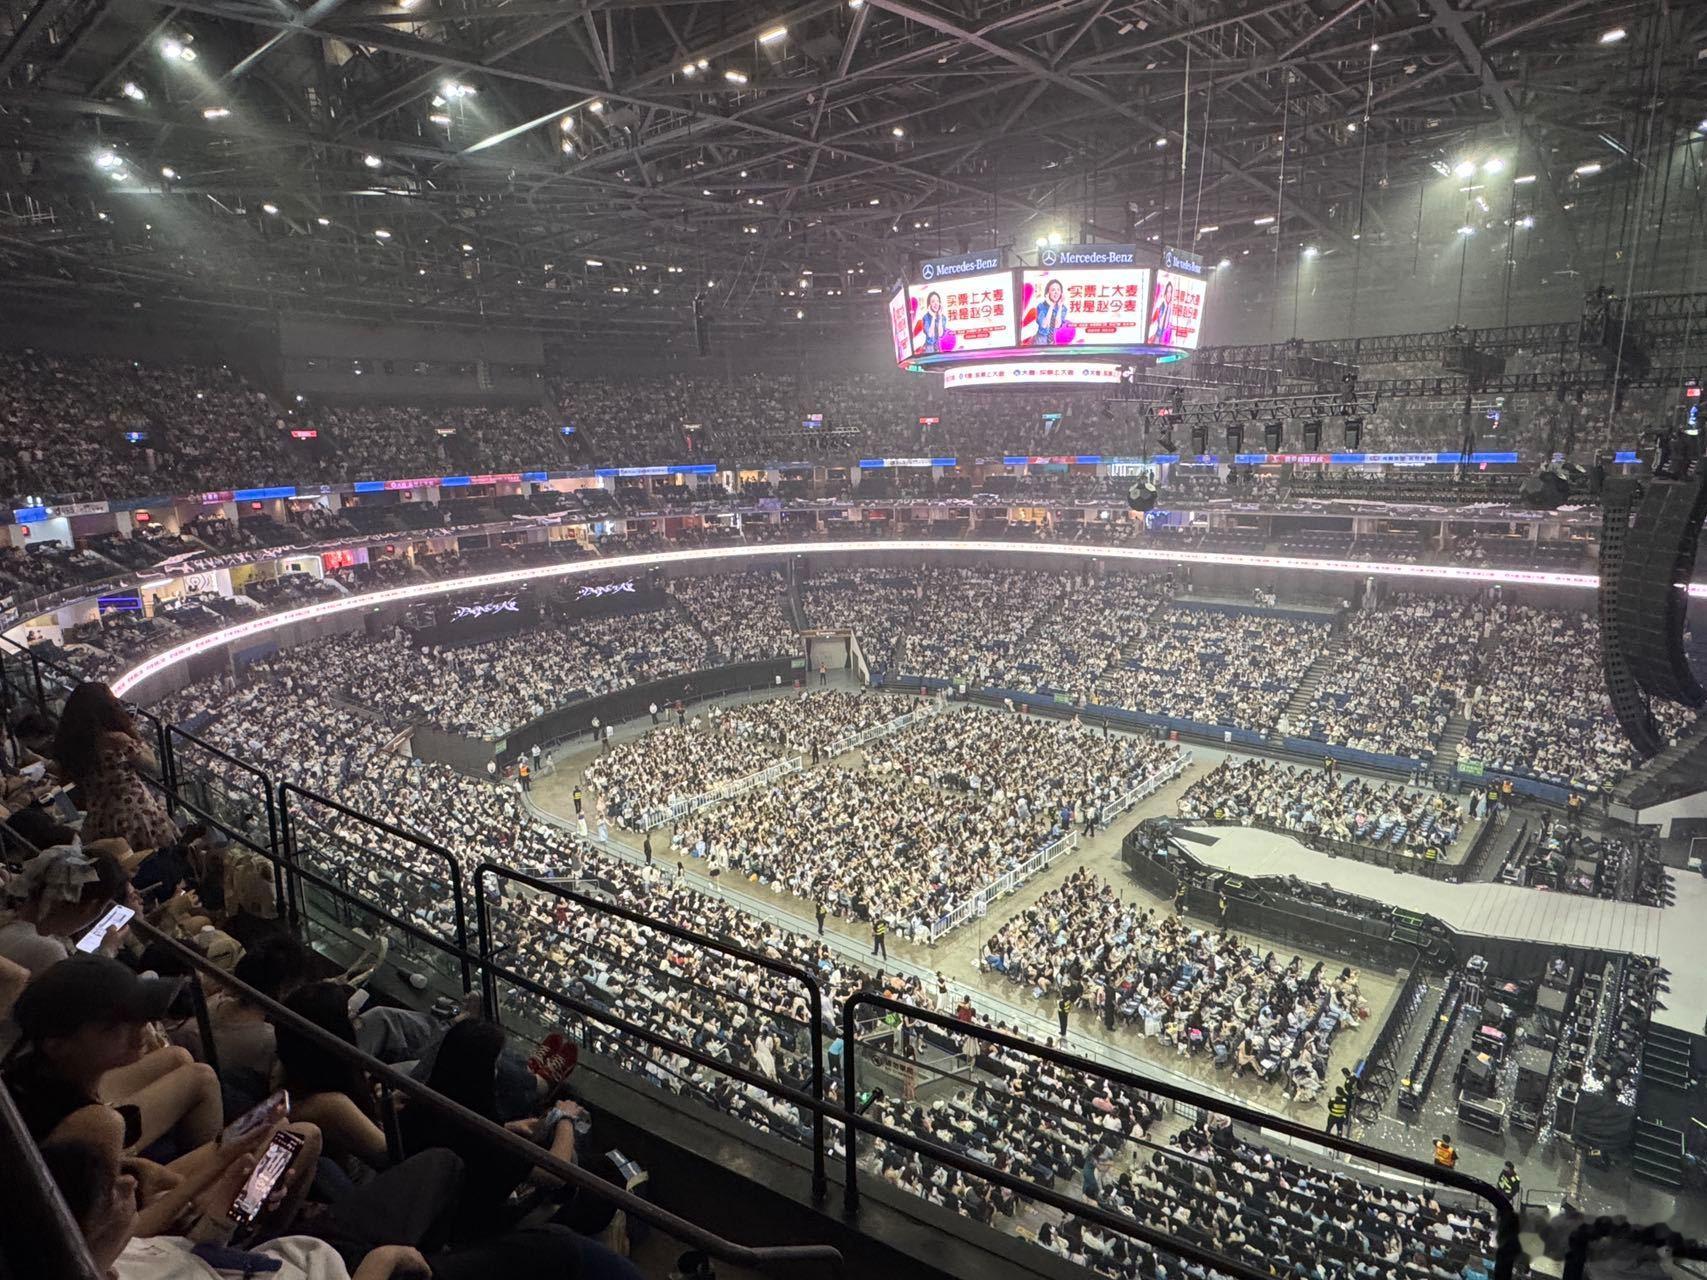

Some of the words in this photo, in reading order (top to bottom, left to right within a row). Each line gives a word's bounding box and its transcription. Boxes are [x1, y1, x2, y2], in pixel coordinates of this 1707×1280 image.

[1060, 251, 1133, 264] Mercedes-Benz
[936, 259, 997, 276] Mercedes-Benz
[946, 289, 1004, 307] 买票上大麦
[1069, 284, 1137, 298] 买票上大麦
[947, 304, 1004, 321] 我是赵今麦
[1069, 299, 1137, 313] 我是赵今麦
